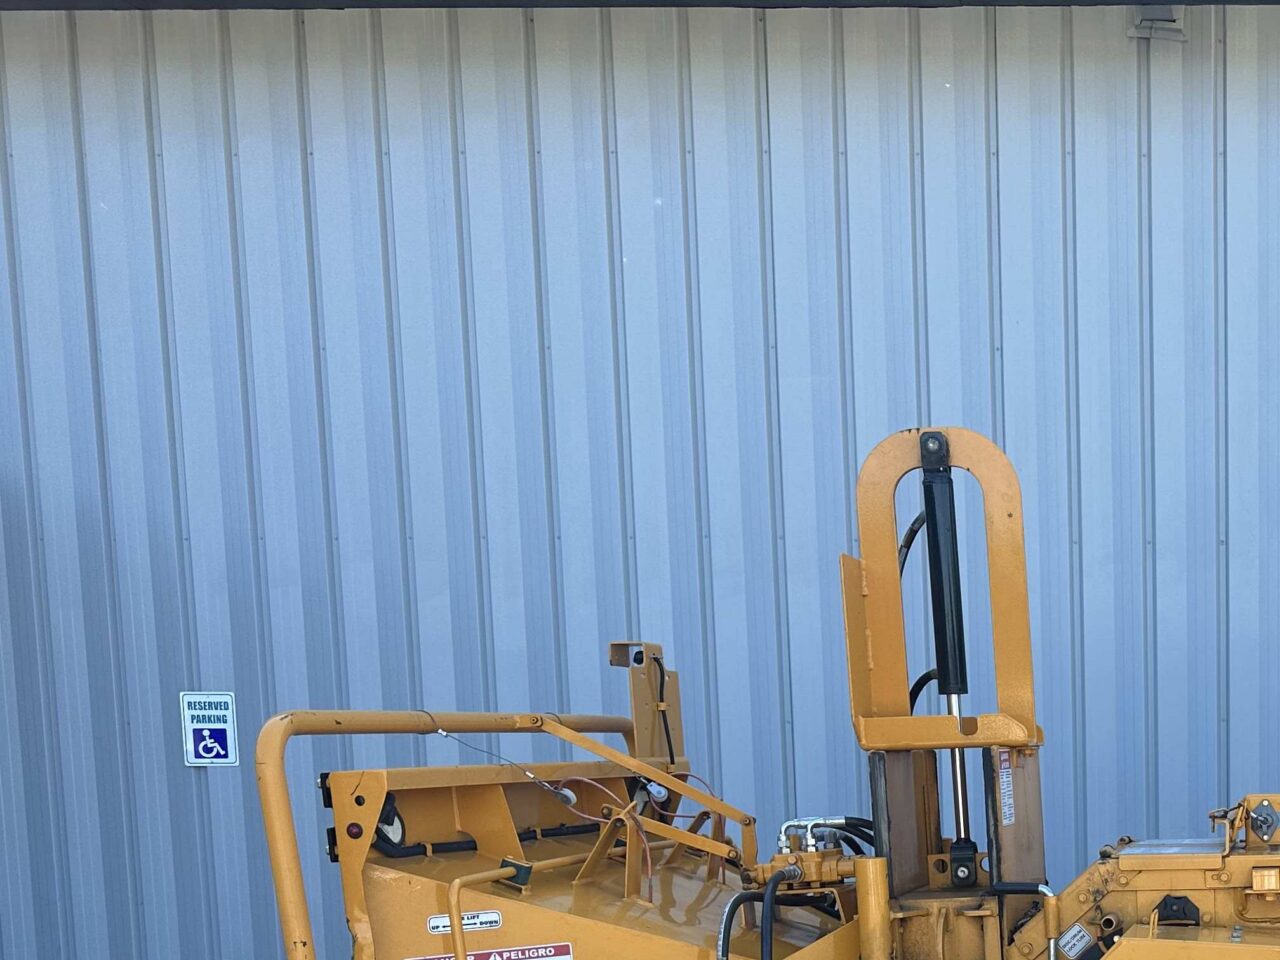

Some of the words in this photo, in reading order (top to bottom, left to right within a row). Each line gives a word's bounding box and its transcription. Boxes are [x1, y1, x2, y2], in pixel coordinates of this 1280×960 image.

[187, 701, 229, 711] RESERVED
[191, 714, 228, 724] PARKING
[503, 947, 555, 960] PELIGRO
